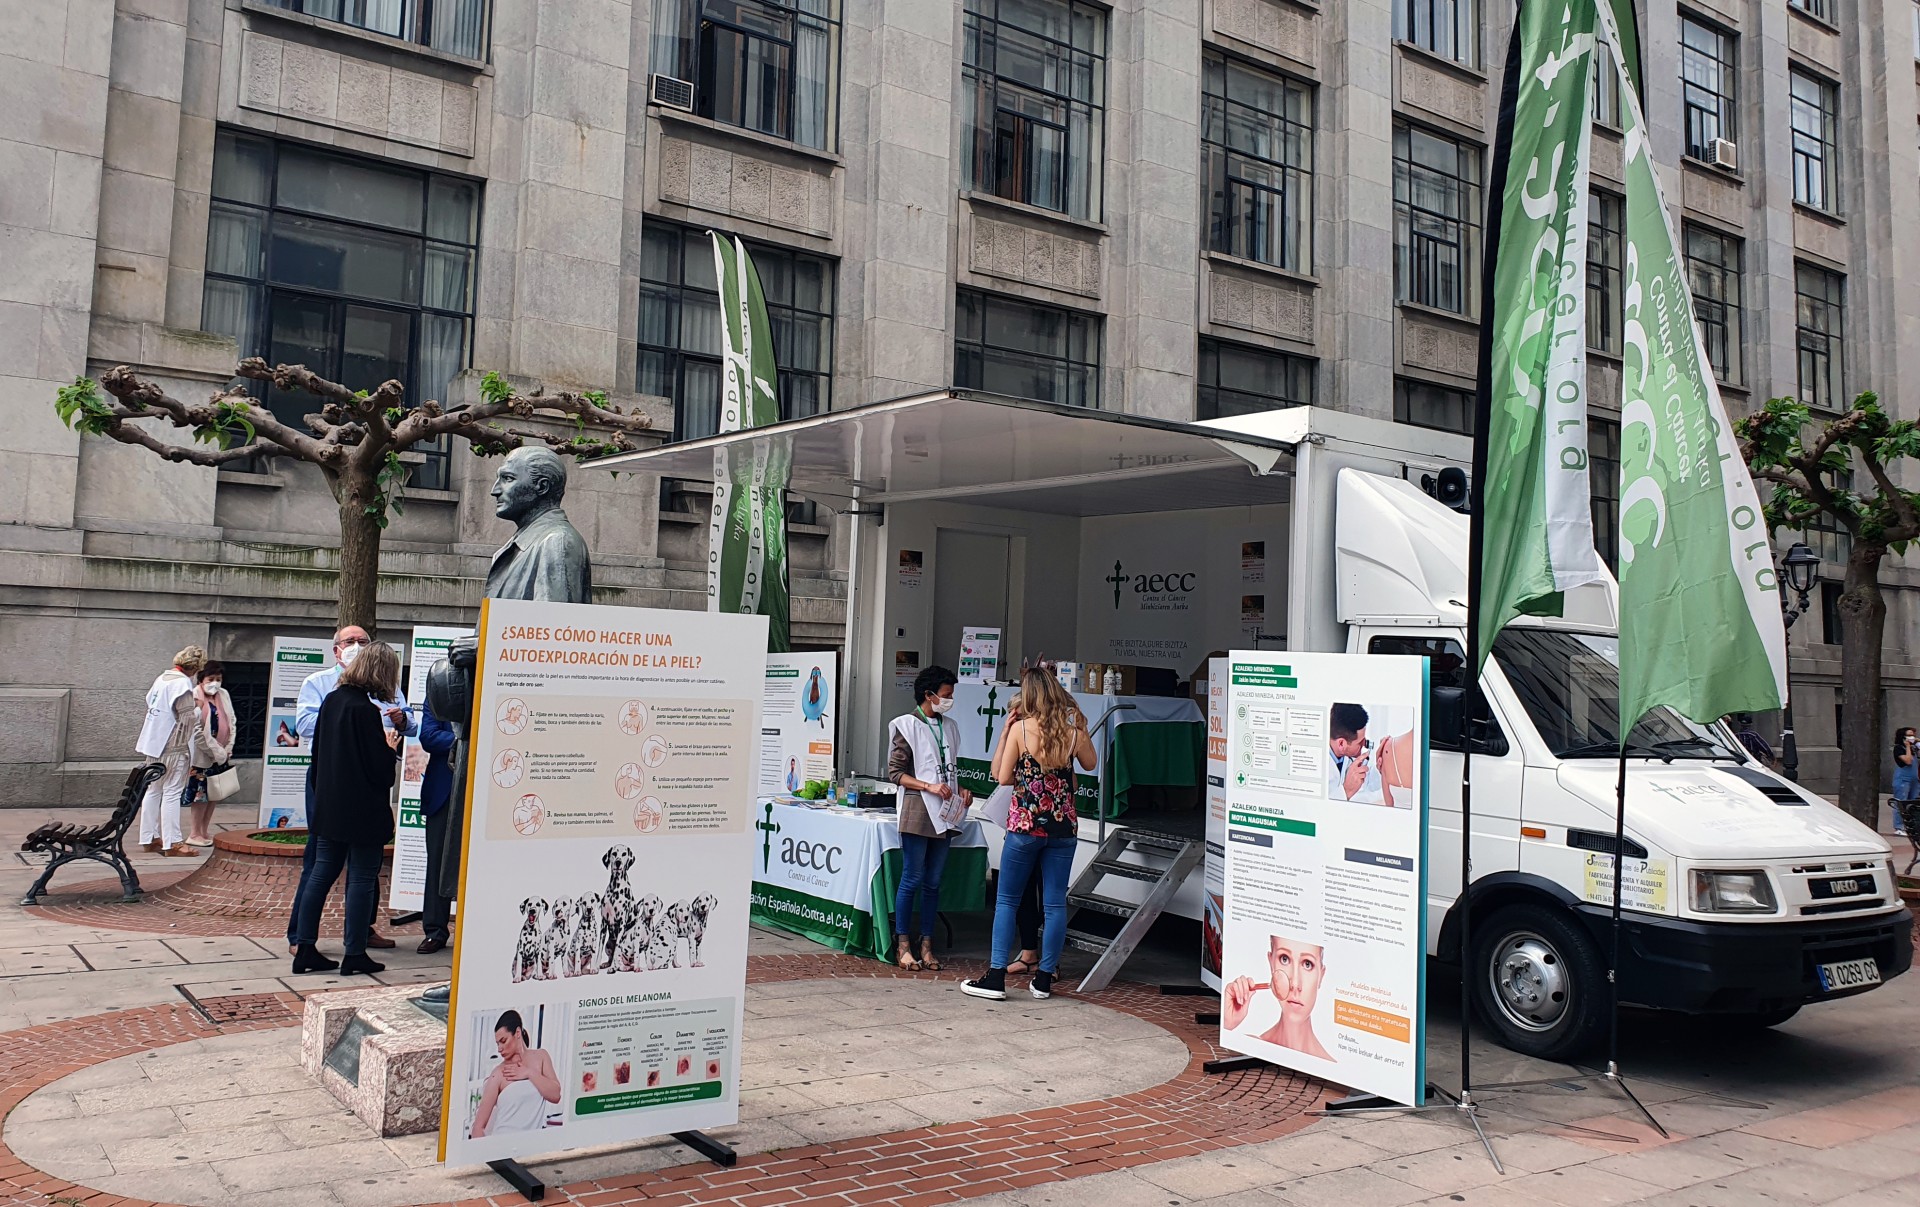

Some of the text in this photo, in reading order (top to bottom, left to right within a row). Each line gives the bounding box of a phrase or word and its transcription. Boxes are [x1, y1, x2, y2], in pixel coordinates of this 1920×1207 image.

[1134, 572, 1196, 593] aecc
[501, 626, 673, 646] ¿SABES CÓMO HACER UNA
[281, 653, 308, 661] UMEAK
[499, 648, 702, 669] AUTOEXPLORACIÓN DE LA PIEL?
[1210, 715, 1223, 733] SOL
[1209, 739, 1217, 755] LA
[1231, 802, 1285, 816] AZALEKO MINBIZIA
[402, 813, 418, 825] LA
[1231, 813, 1278, 828] MOTA NAGUSIAK
[781, 837, 843, 875] aecc
[1375, 856, 1402, 866] MELANOMA
[1829, 879, 1860, 894] IVECO
[768, 895, 800, 915] Española
[801, 903, 826, 923] Contra
[825, 912, 834, 925] el
[1836, 963, 1863, 985] 0269
[1863, 960, 1879, 981] CC
[578, 991, 672, 1008] SIGNOS DEL MELANOMA
